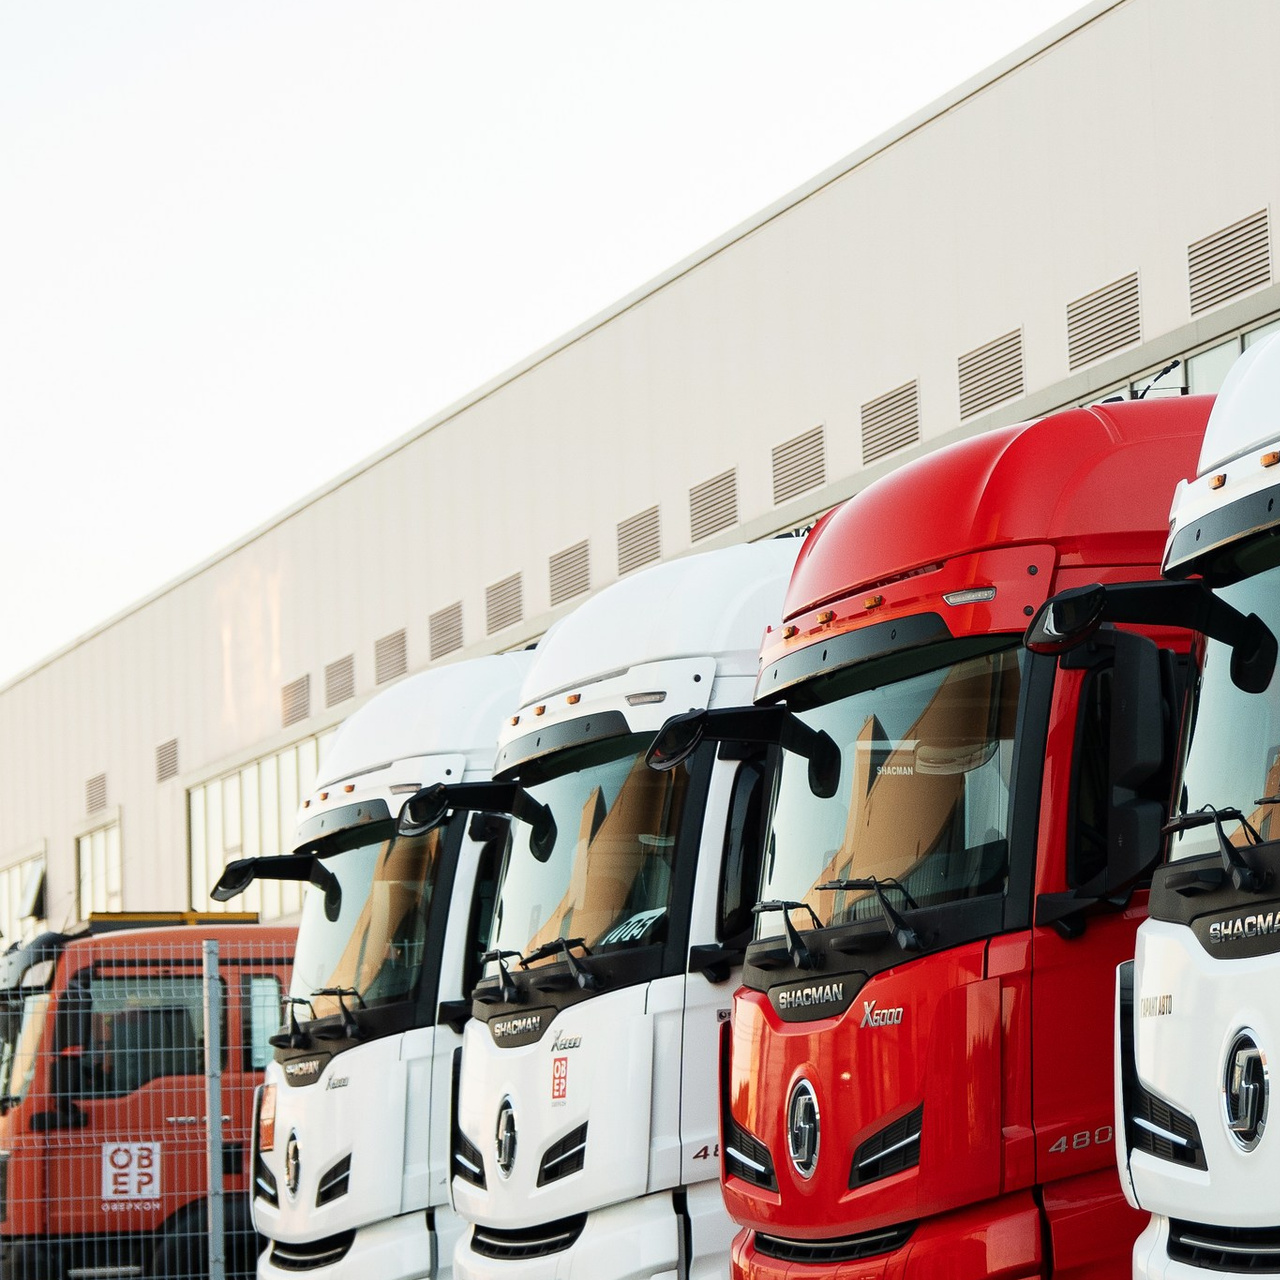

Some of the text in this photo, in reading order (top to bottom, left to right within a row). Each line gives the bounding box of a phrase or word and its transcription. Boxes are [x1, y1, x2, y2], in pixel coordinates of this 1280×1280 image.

[876, 765, 914, 776] SHACMAN
[779, 983, 844, 1009] SHACMAN
[1158, 994, 1173, 1015] АВТО
[860, 1000, 904, 1029] X6000
[494, 1016, 541, 1037] SHACMAN
[1048, 1125, 1113, 1153] 480
